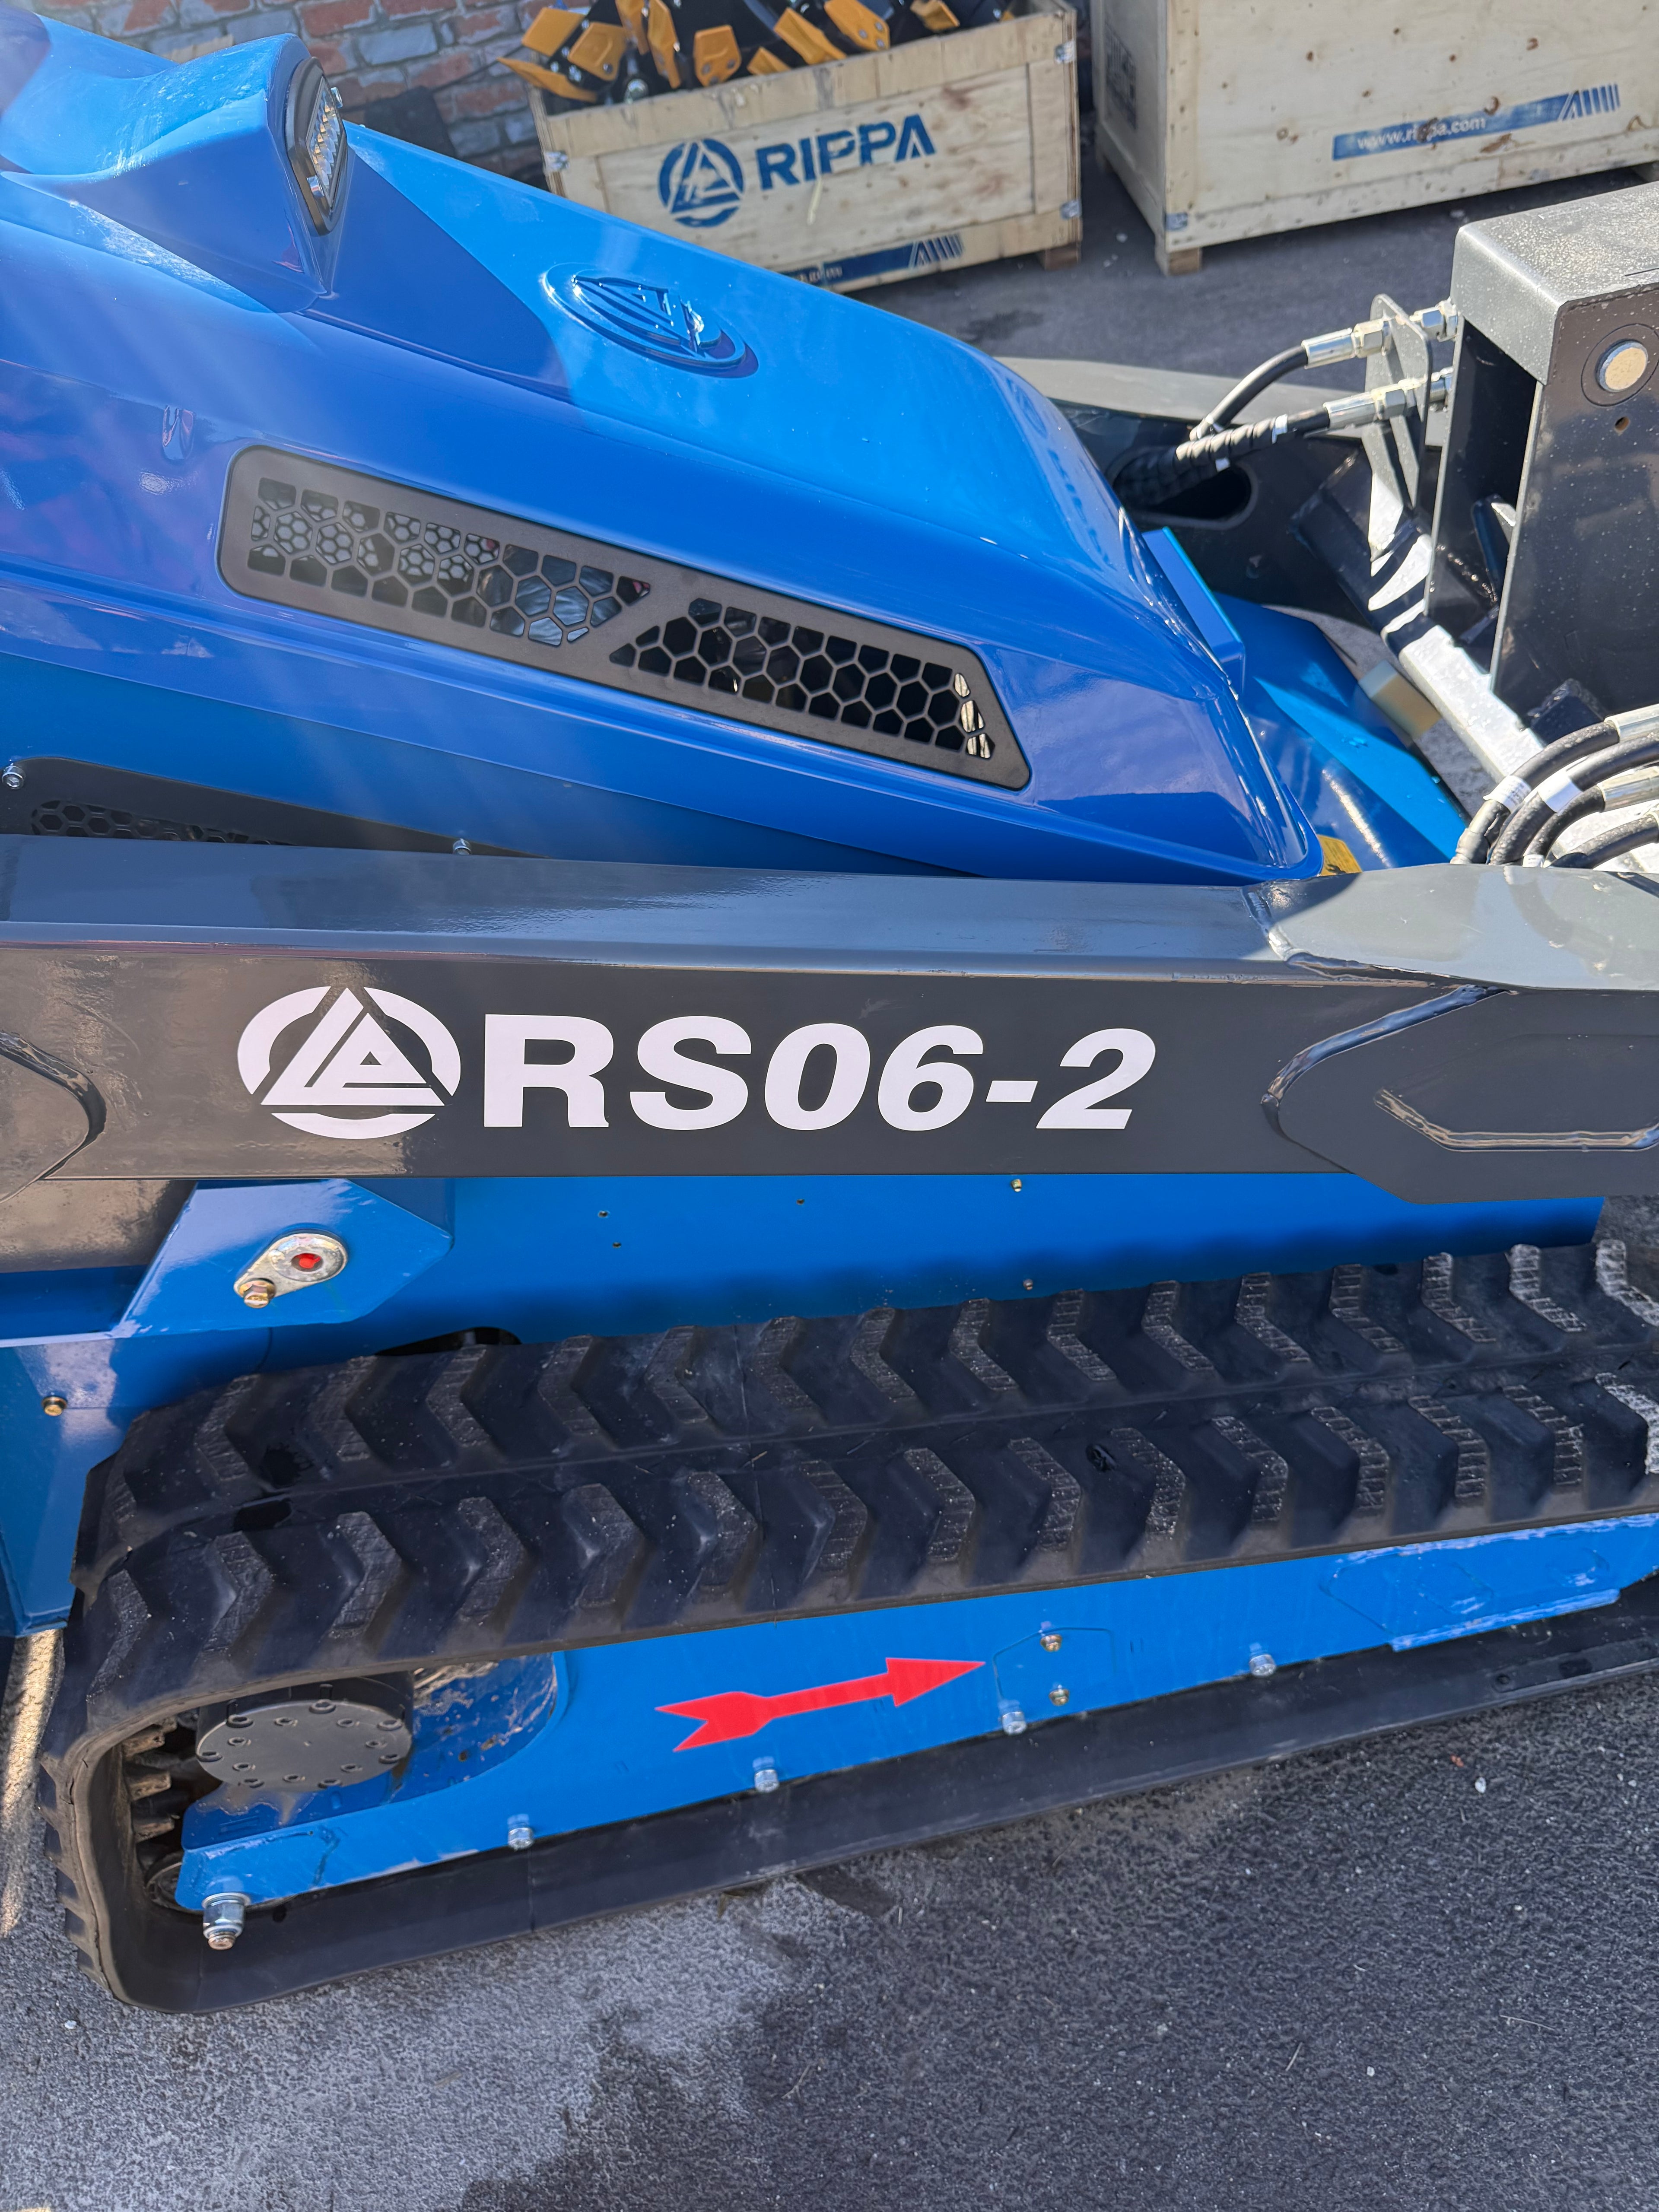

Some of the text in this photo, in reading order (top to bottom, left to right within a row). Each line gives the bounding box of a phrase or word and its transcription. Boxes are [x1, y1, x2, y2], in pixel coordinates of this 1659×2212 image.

[755, 114, 935, 191] RIPPA
[1357, 117, 1486, 149] www.ripa.com
[484, 1014, 1156, 1131] RS06-2
